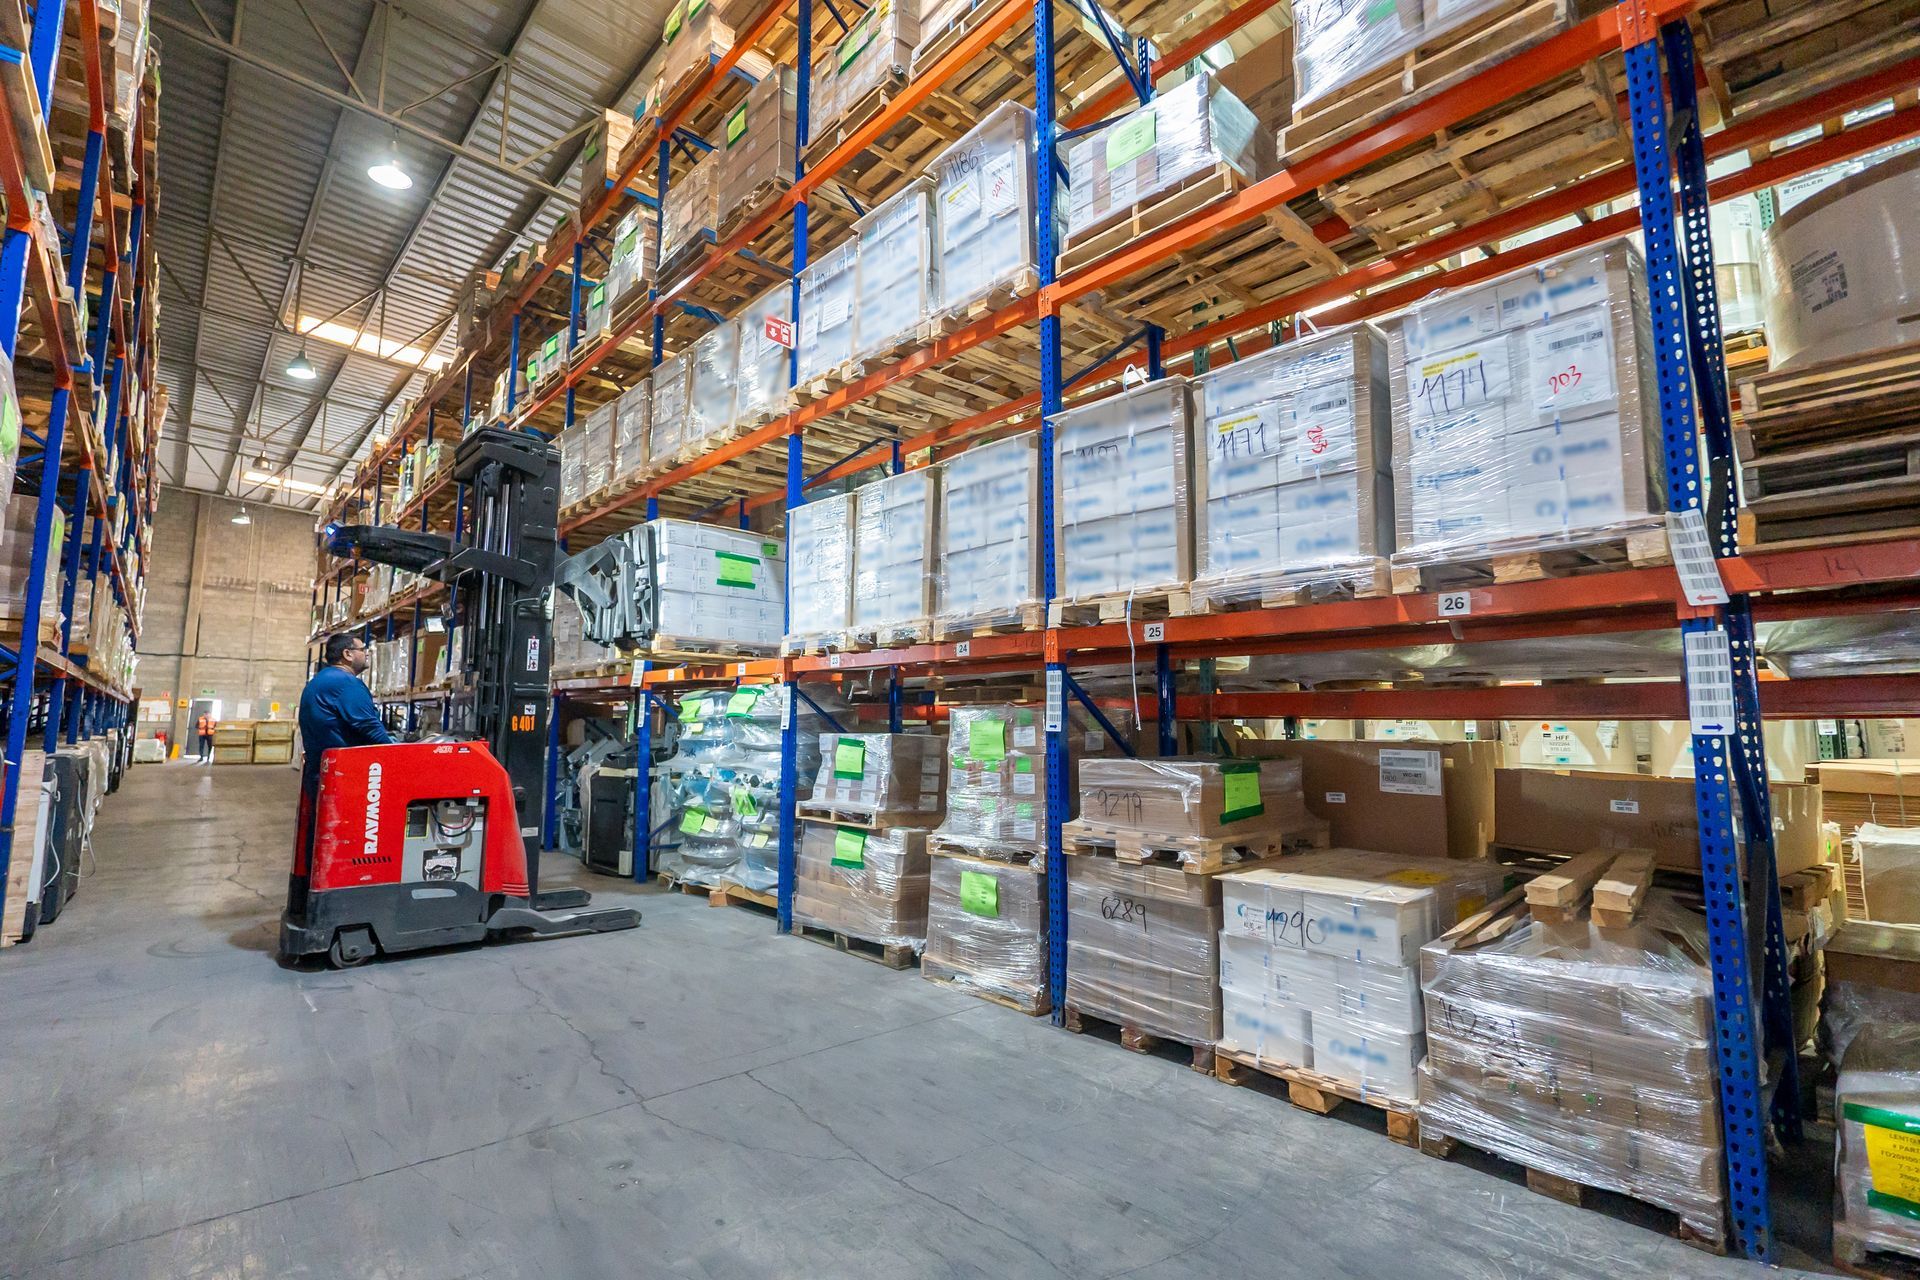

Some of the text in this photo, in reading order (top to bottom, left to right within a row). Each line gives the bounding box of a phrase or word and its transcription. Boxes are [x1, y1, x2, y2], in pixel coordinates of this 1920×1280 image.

[1216, 421, 1267, 457] 1171
[1444, 596, 1465, 611] 26
[1148, 626, 1162, 638] 25
[958, 644, 968, 653] 24
[519, 715, 535, 731] 401
[363, 762, 383, 855] RAYMOND
[1101, 896, 1147, 933] 6289
